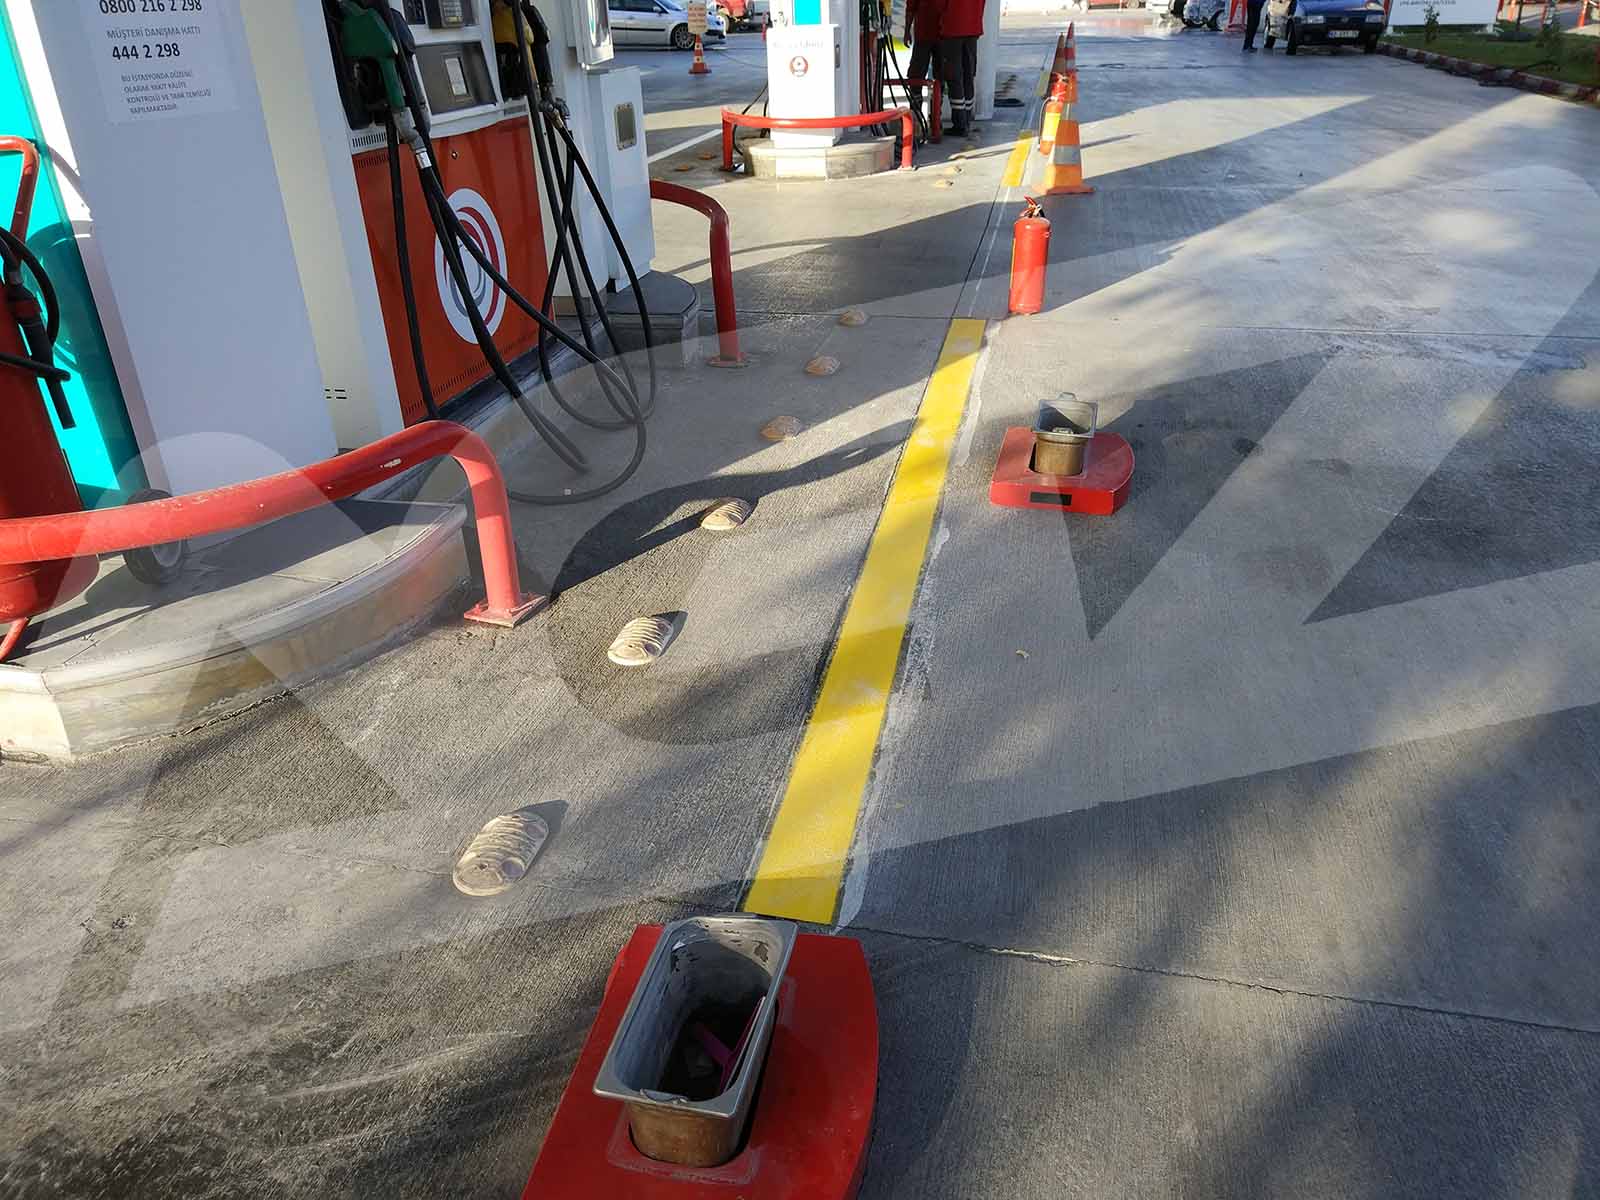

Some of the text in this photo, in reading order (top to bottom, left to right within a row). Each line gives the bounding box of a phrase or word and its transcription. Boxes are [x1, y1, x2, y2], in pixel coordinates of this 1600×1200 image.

[99, 0, 136, 14] 0800
[140, 0, 165, 12] 216
[182, 0, 203, 11] 298
[112, 42, 181, 60] 444 2 298
